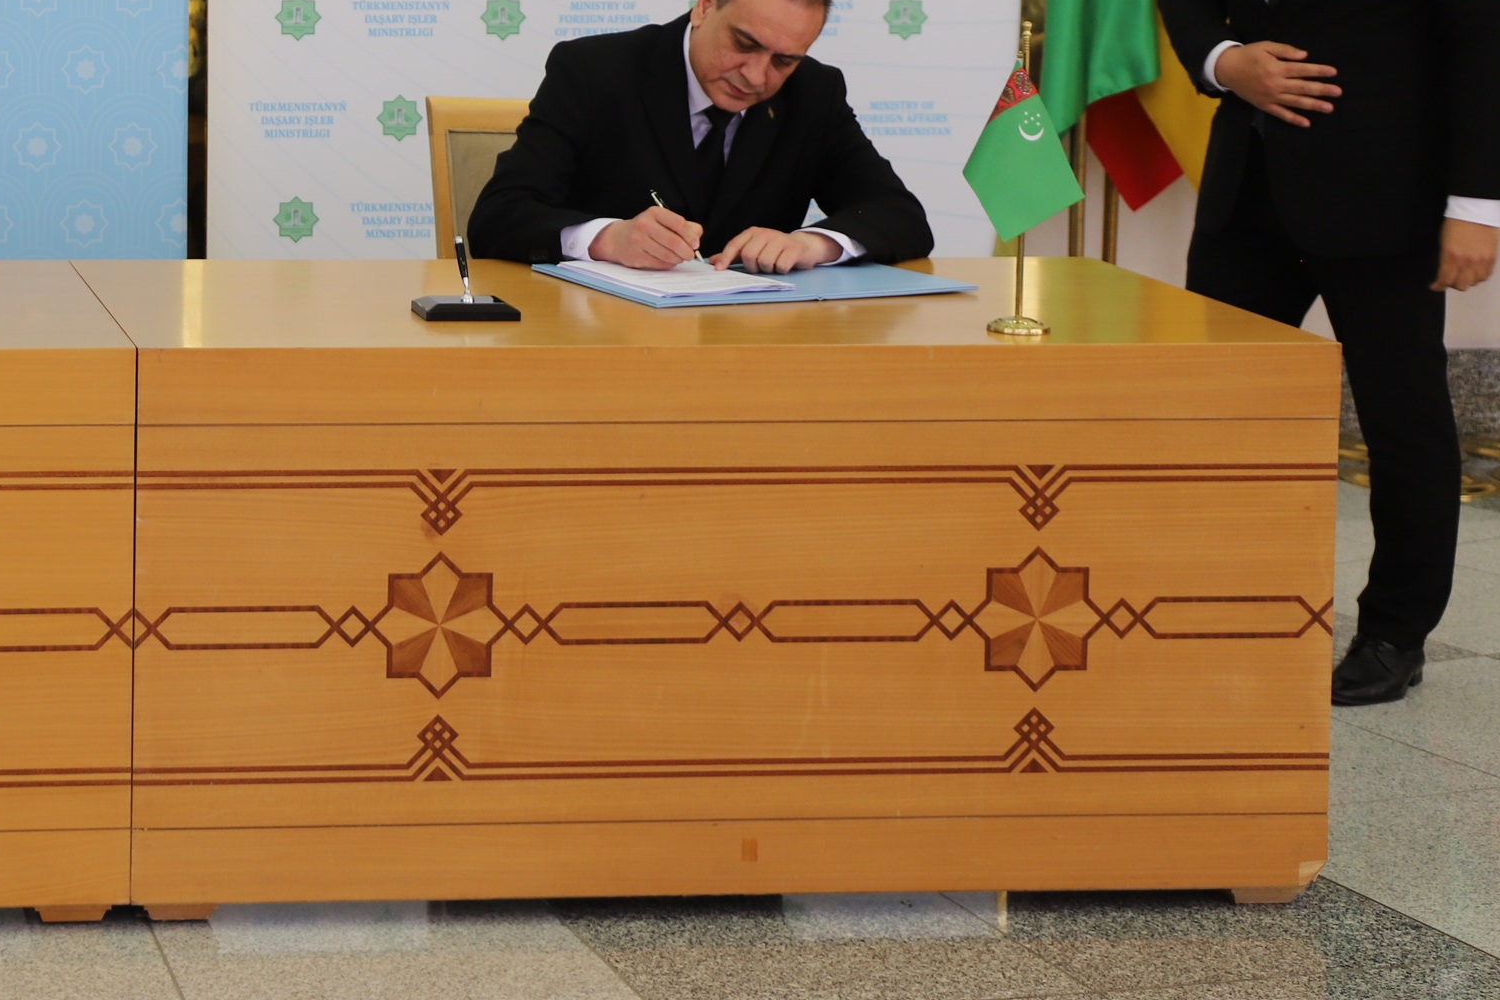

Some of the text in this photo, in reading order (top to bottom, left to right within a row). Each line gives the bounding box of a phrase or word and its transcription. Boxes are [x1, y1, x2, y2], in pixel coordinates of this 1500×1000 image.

[570, 1, 637, 10] MINISTRY OF
[365, 14, 437, 25] DAŞARY IŞLER
[559, 14, 605, 23] FOREIGN
[367, 28, 434, 37] MINISTRLIGI
[260, 116, 335, 126] DAŞARY IŞLER
[264, 129, 331, 139] MINISTRLIGI
[366, 229, 431, 239] MINISTRLIGI
